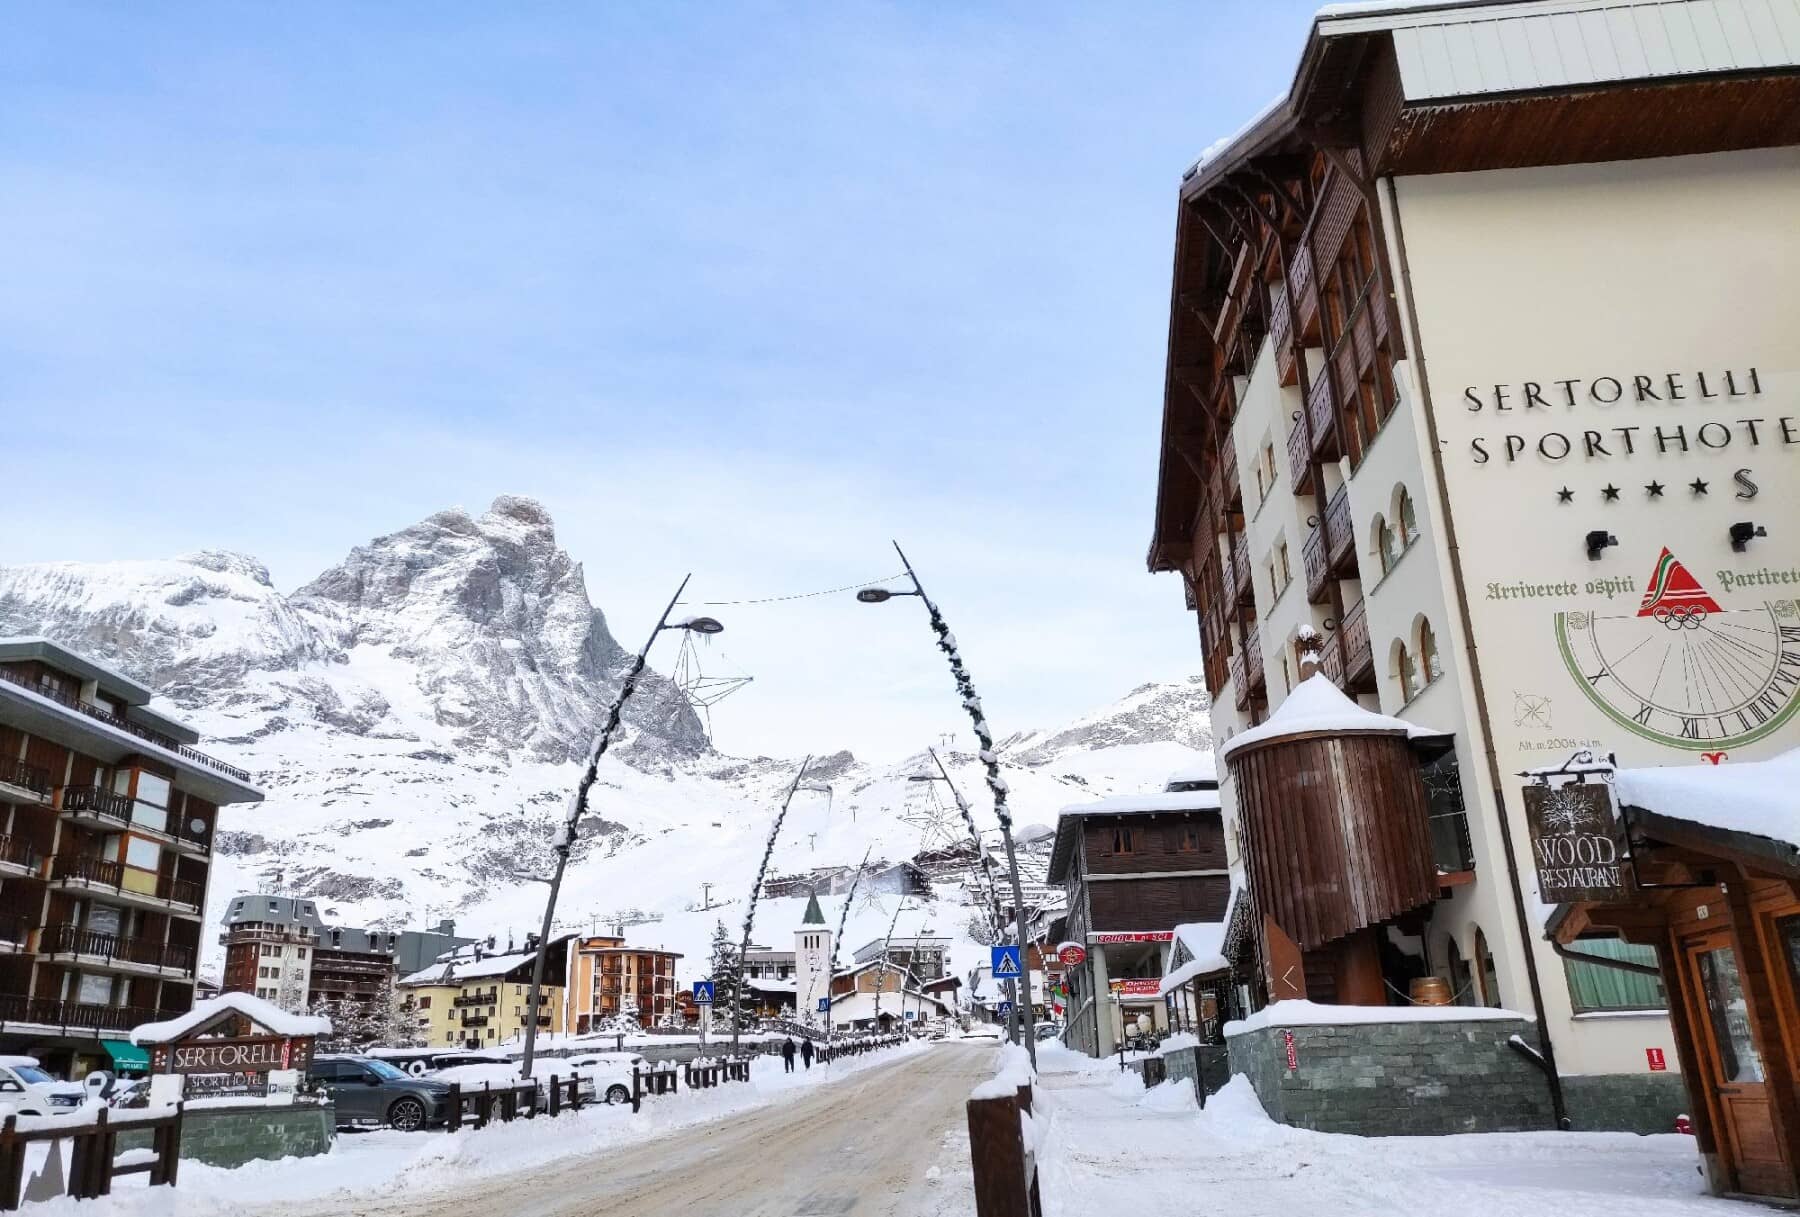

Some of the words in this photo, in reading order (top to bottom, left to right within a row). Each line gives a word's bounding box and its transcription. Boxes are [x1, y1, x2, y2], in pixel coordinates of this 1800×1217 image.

[1464, 367, 1762, 412] SERTORELLI
[1486, 581, 1577, 600] Arriverete
[1585, 576, 1635, 600] ospiti
[1716, 567, 1800, 592] Partiret
[1587, 667, 1609, 686] X
[1632, 703, 1653, 725] XI
[1681, 717, 1699, 739] XII
[1735, 711, 1753, 731] II
[1747, 702, 1769, 723] III
[1769, 681, 1788, 698] V
[1535, 836, 1616, 867] WOOD
[1540, 866, 1622, 889] RESTAURANT
[174, 1043, 284, 1068] SERTORELLI
